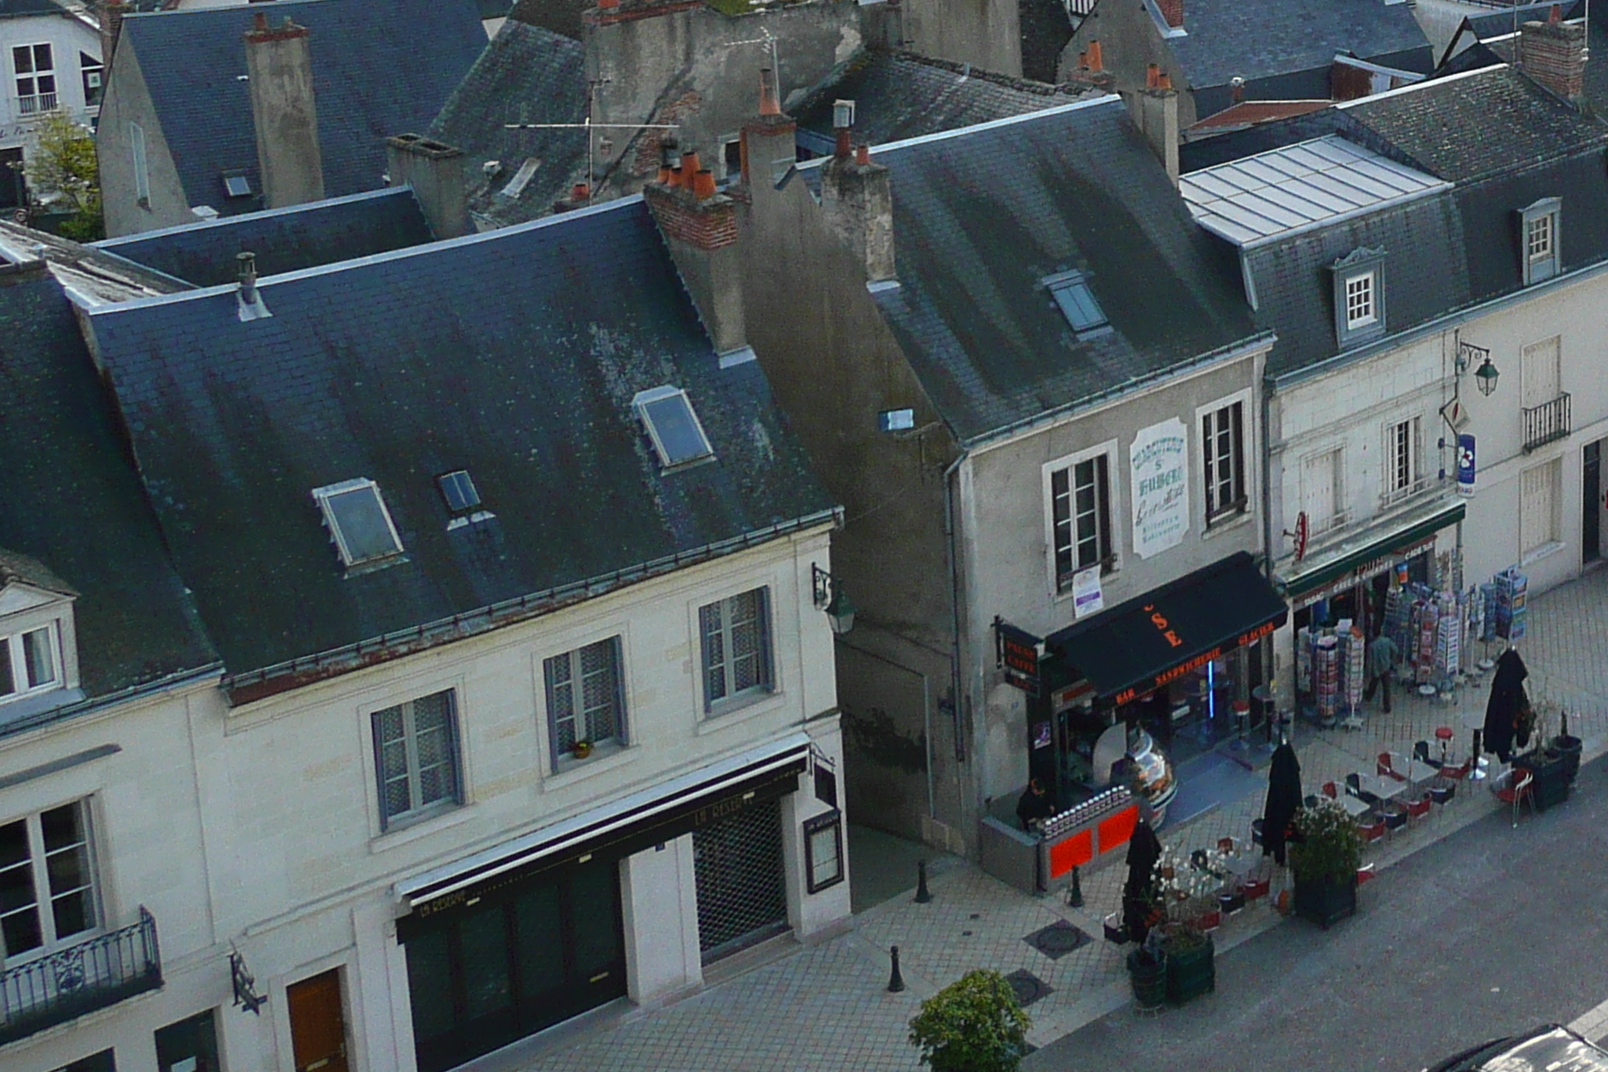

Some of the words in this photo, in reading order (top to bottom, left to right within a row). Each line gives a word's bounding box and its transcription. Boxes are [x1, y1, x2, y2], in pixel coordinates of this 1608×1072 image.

[1116, 688, 1136, 705] BAR
[1155, 647, 1222, 685] SANDWICHERIE
[1239, 622, 1275, 646] GLACIER
